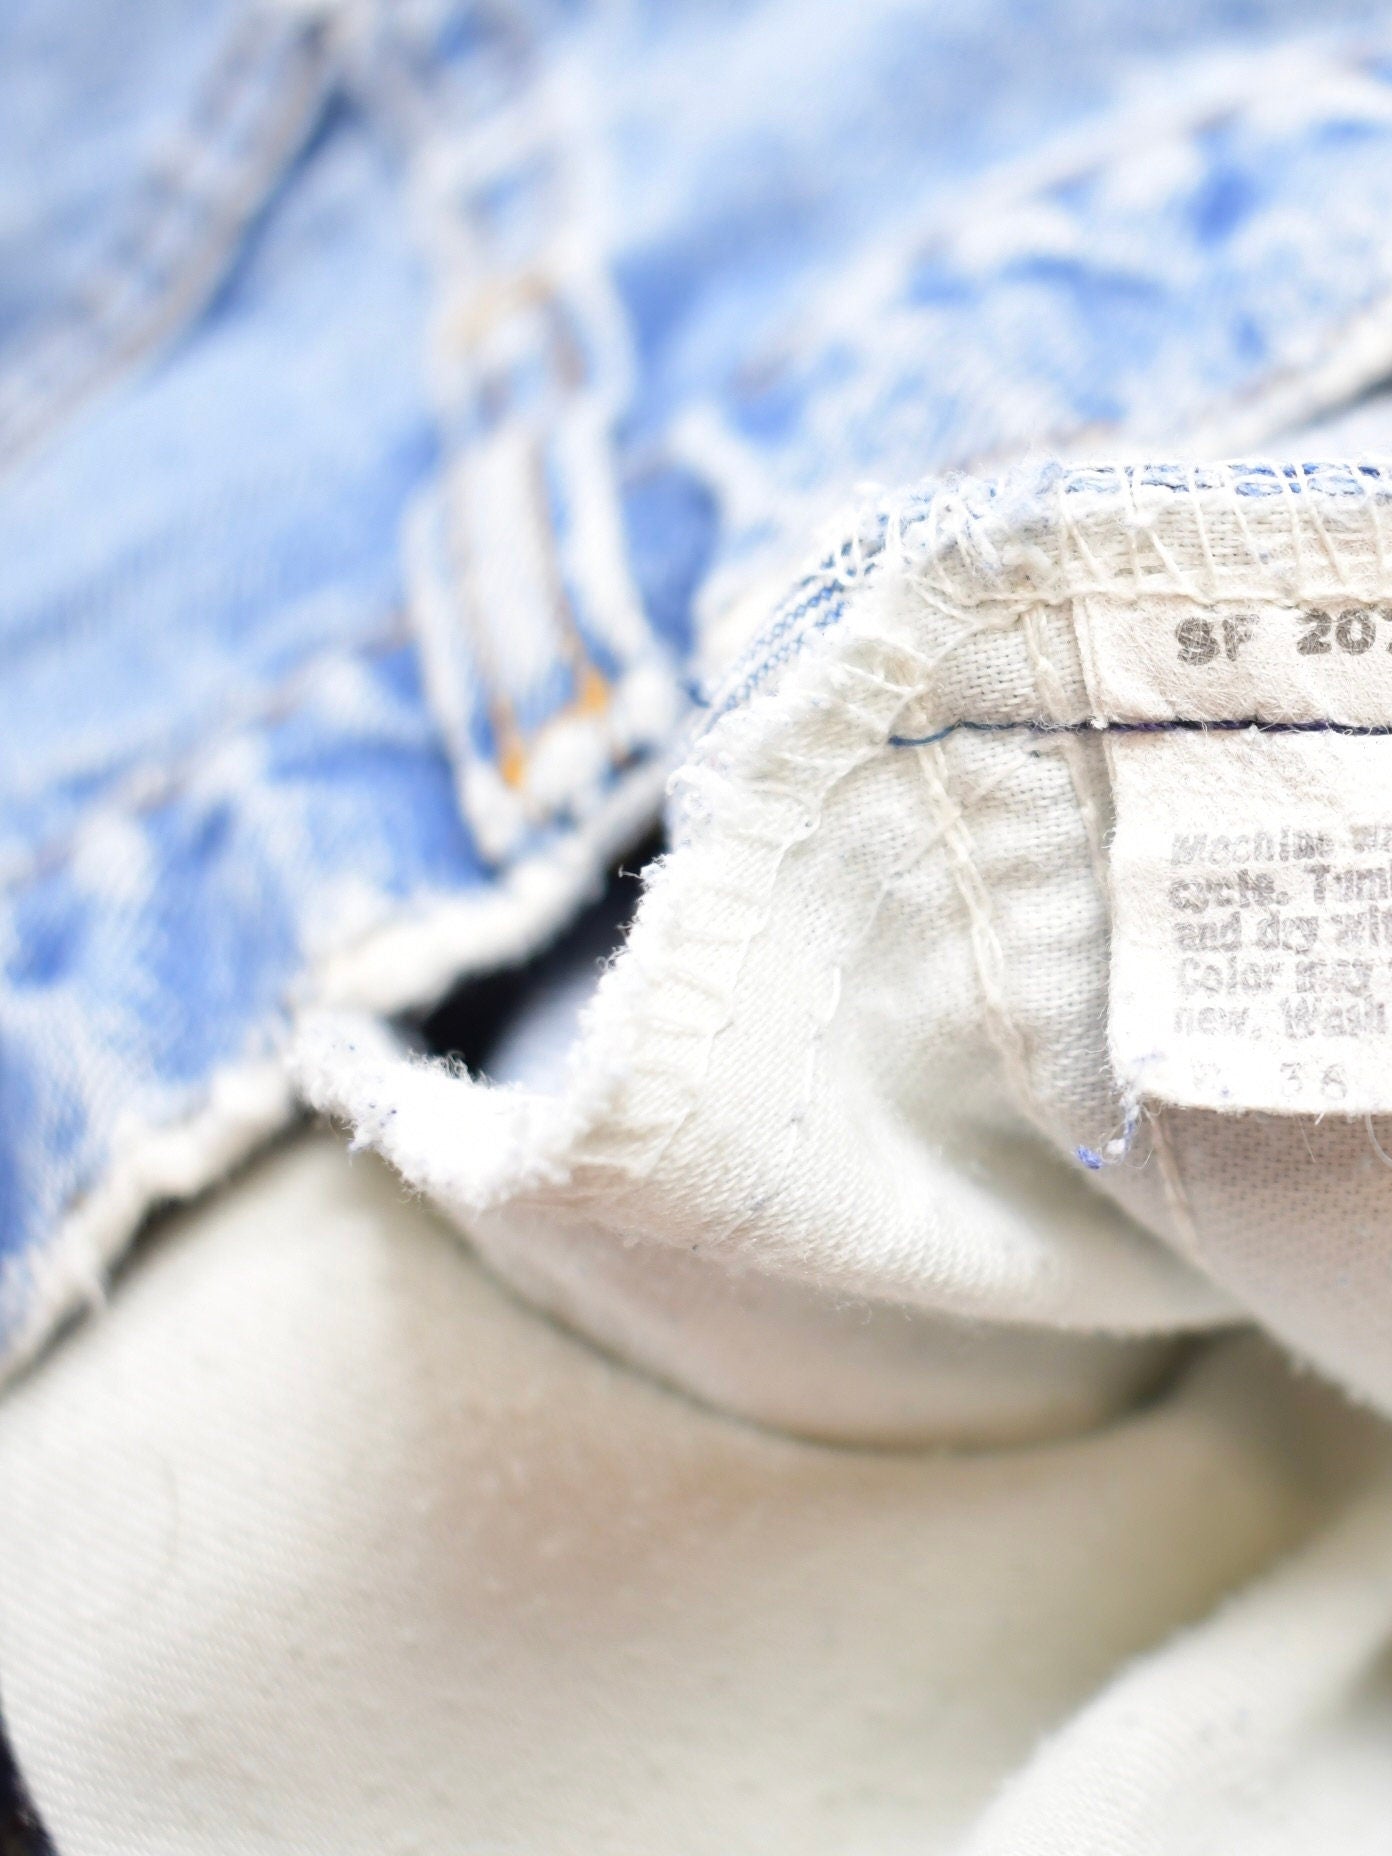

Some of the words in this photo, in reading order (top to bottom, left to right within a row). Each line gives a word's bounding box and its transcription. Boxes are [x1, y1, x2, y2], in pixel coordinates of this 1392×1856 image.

[1175, 613, 1261, 666] SF
[1174, 910, 1242, 951] and
[1255, 909, 1319, 955] dry
[1178, 955, 1284, 996] Color
